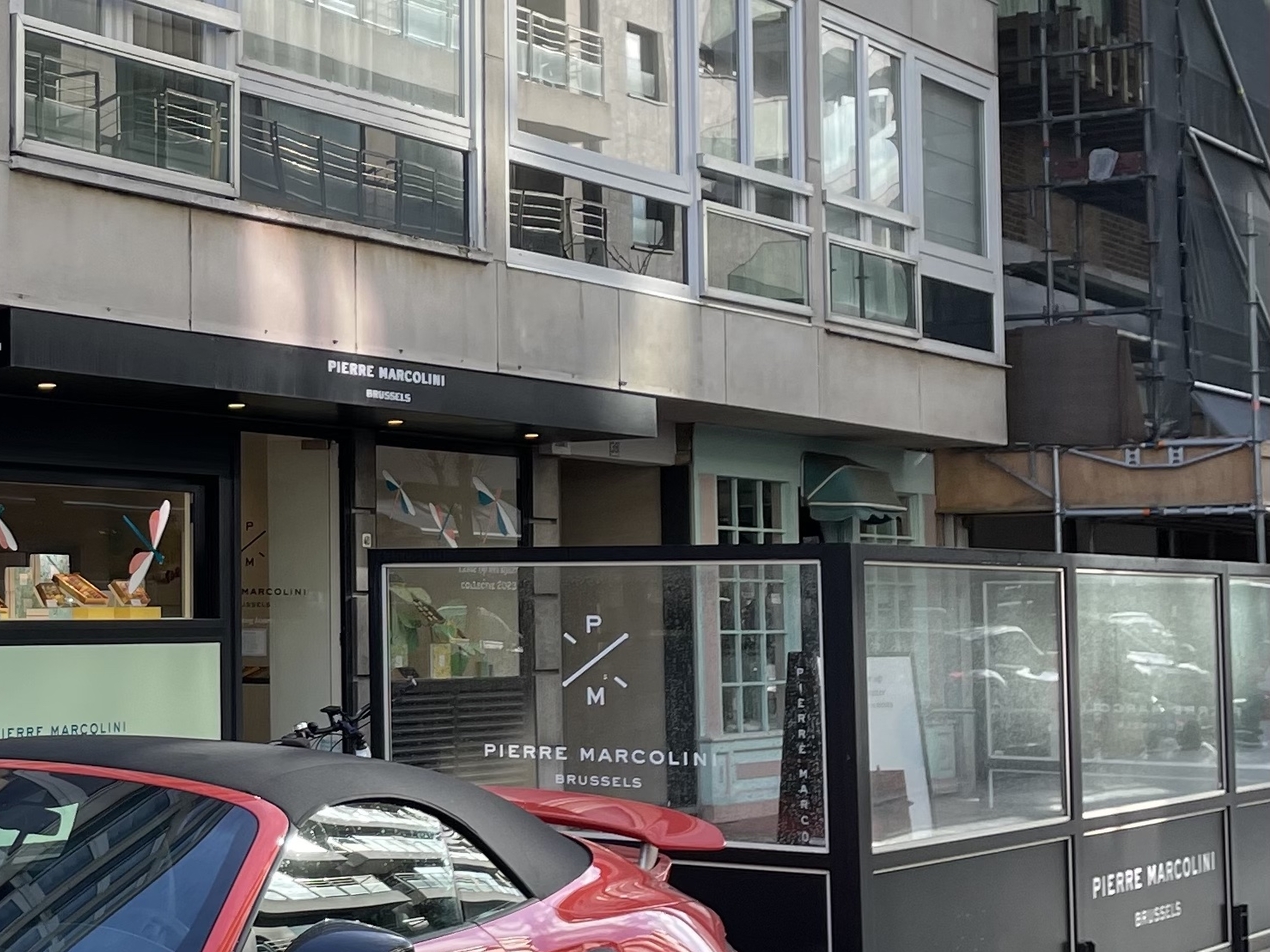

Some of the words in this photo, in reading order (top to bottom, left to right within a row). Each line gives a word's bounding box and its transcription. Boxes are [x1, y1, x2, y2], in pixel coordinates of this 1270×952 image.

[327, 359, 375, 378] PIERRE
[378, 366, 445, 387] MARCOLINI
[365, 388, 411, 403] BRUSSELS
[240, 587, 307, 596] MARCOLINI
[585, 613, 603, 633] P
[586, 686, 605, 706] M
[796, 667, 807, 755] PIERRE
[50, 720, 127, 736] MARCOLINI
[483, 743, 568, 761] PIERRE
[579, 746, 717, 768] MARCOLINI
[555, 774, 642, 789] BRUSSELS
[1092, 866, 1143, 900] PIERRE
[1146, 850, 1216, 887] MARCOLINI
